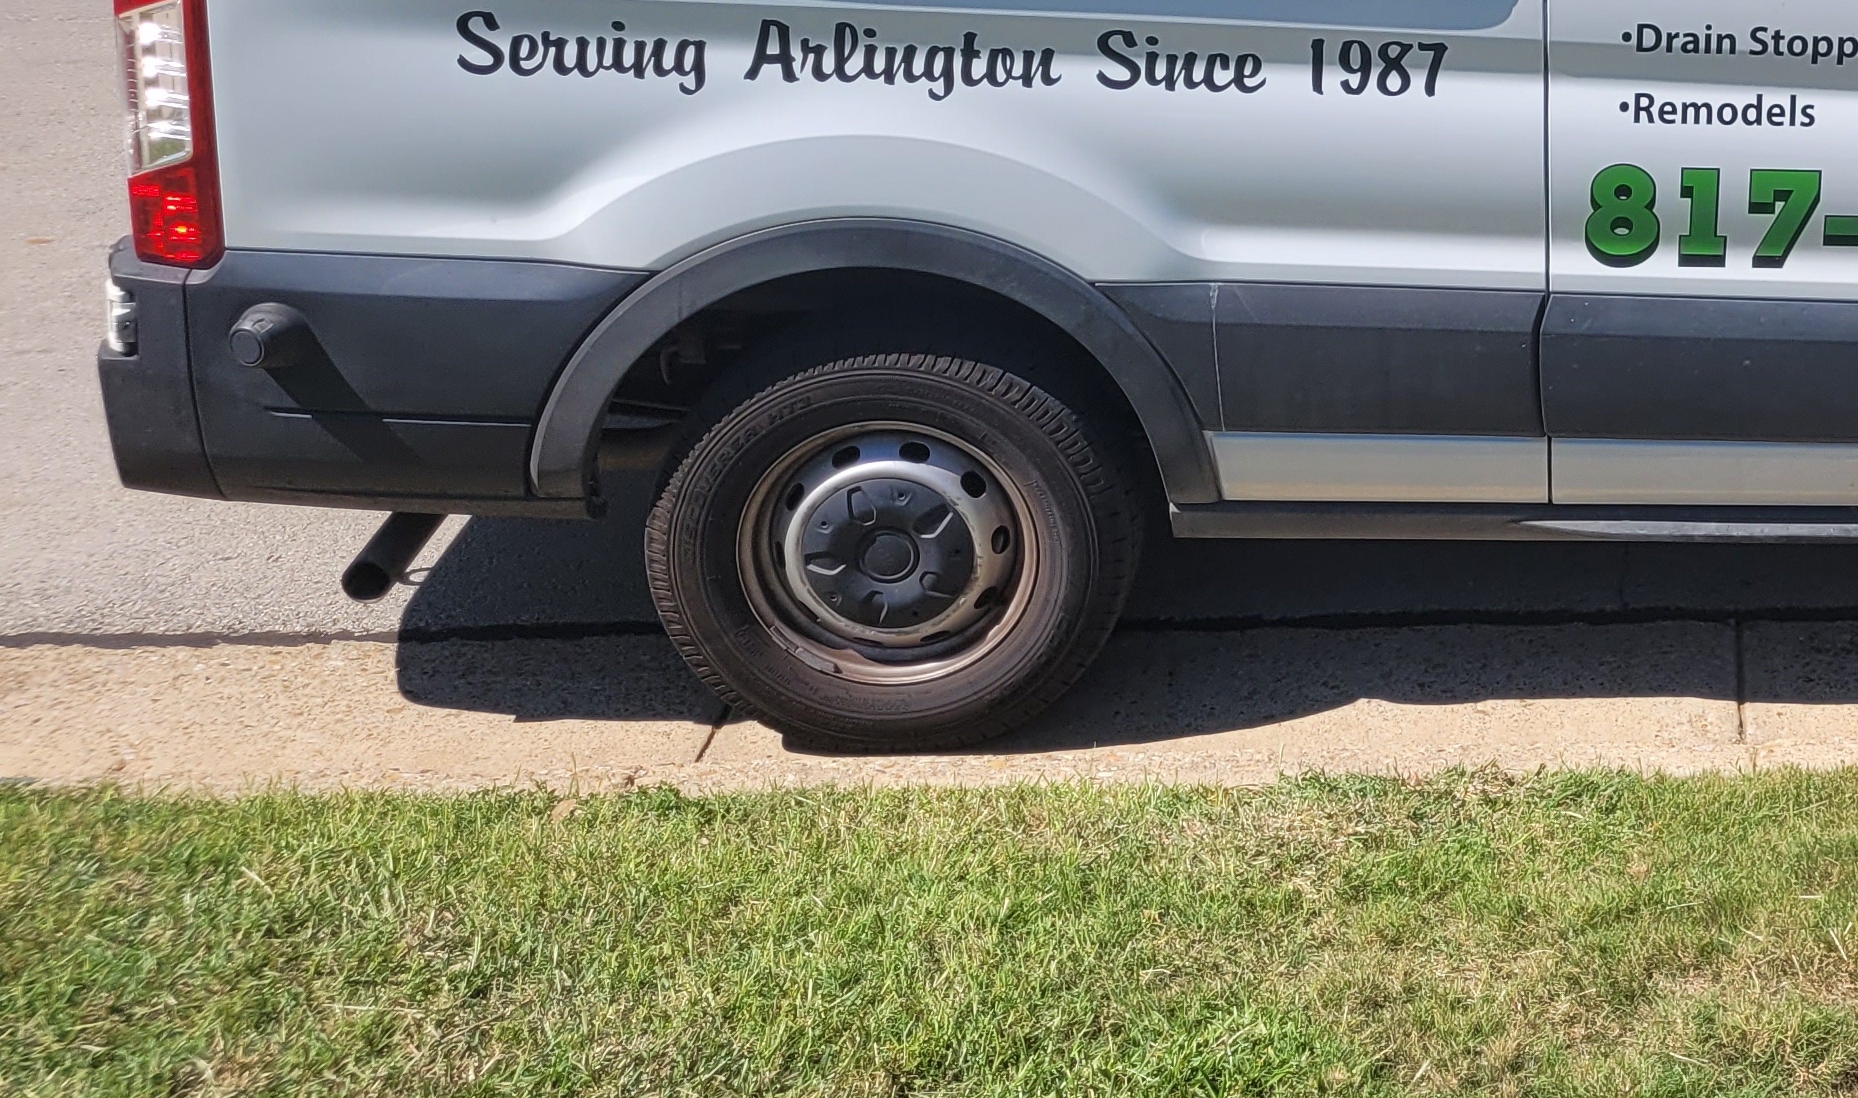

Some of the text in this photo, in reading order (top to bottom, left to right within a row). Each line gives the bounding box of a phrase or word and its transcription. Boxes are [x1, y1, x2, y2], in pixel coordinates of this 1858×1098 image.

[455, 10, 1450, 102] Serving Arlington Since 1987
